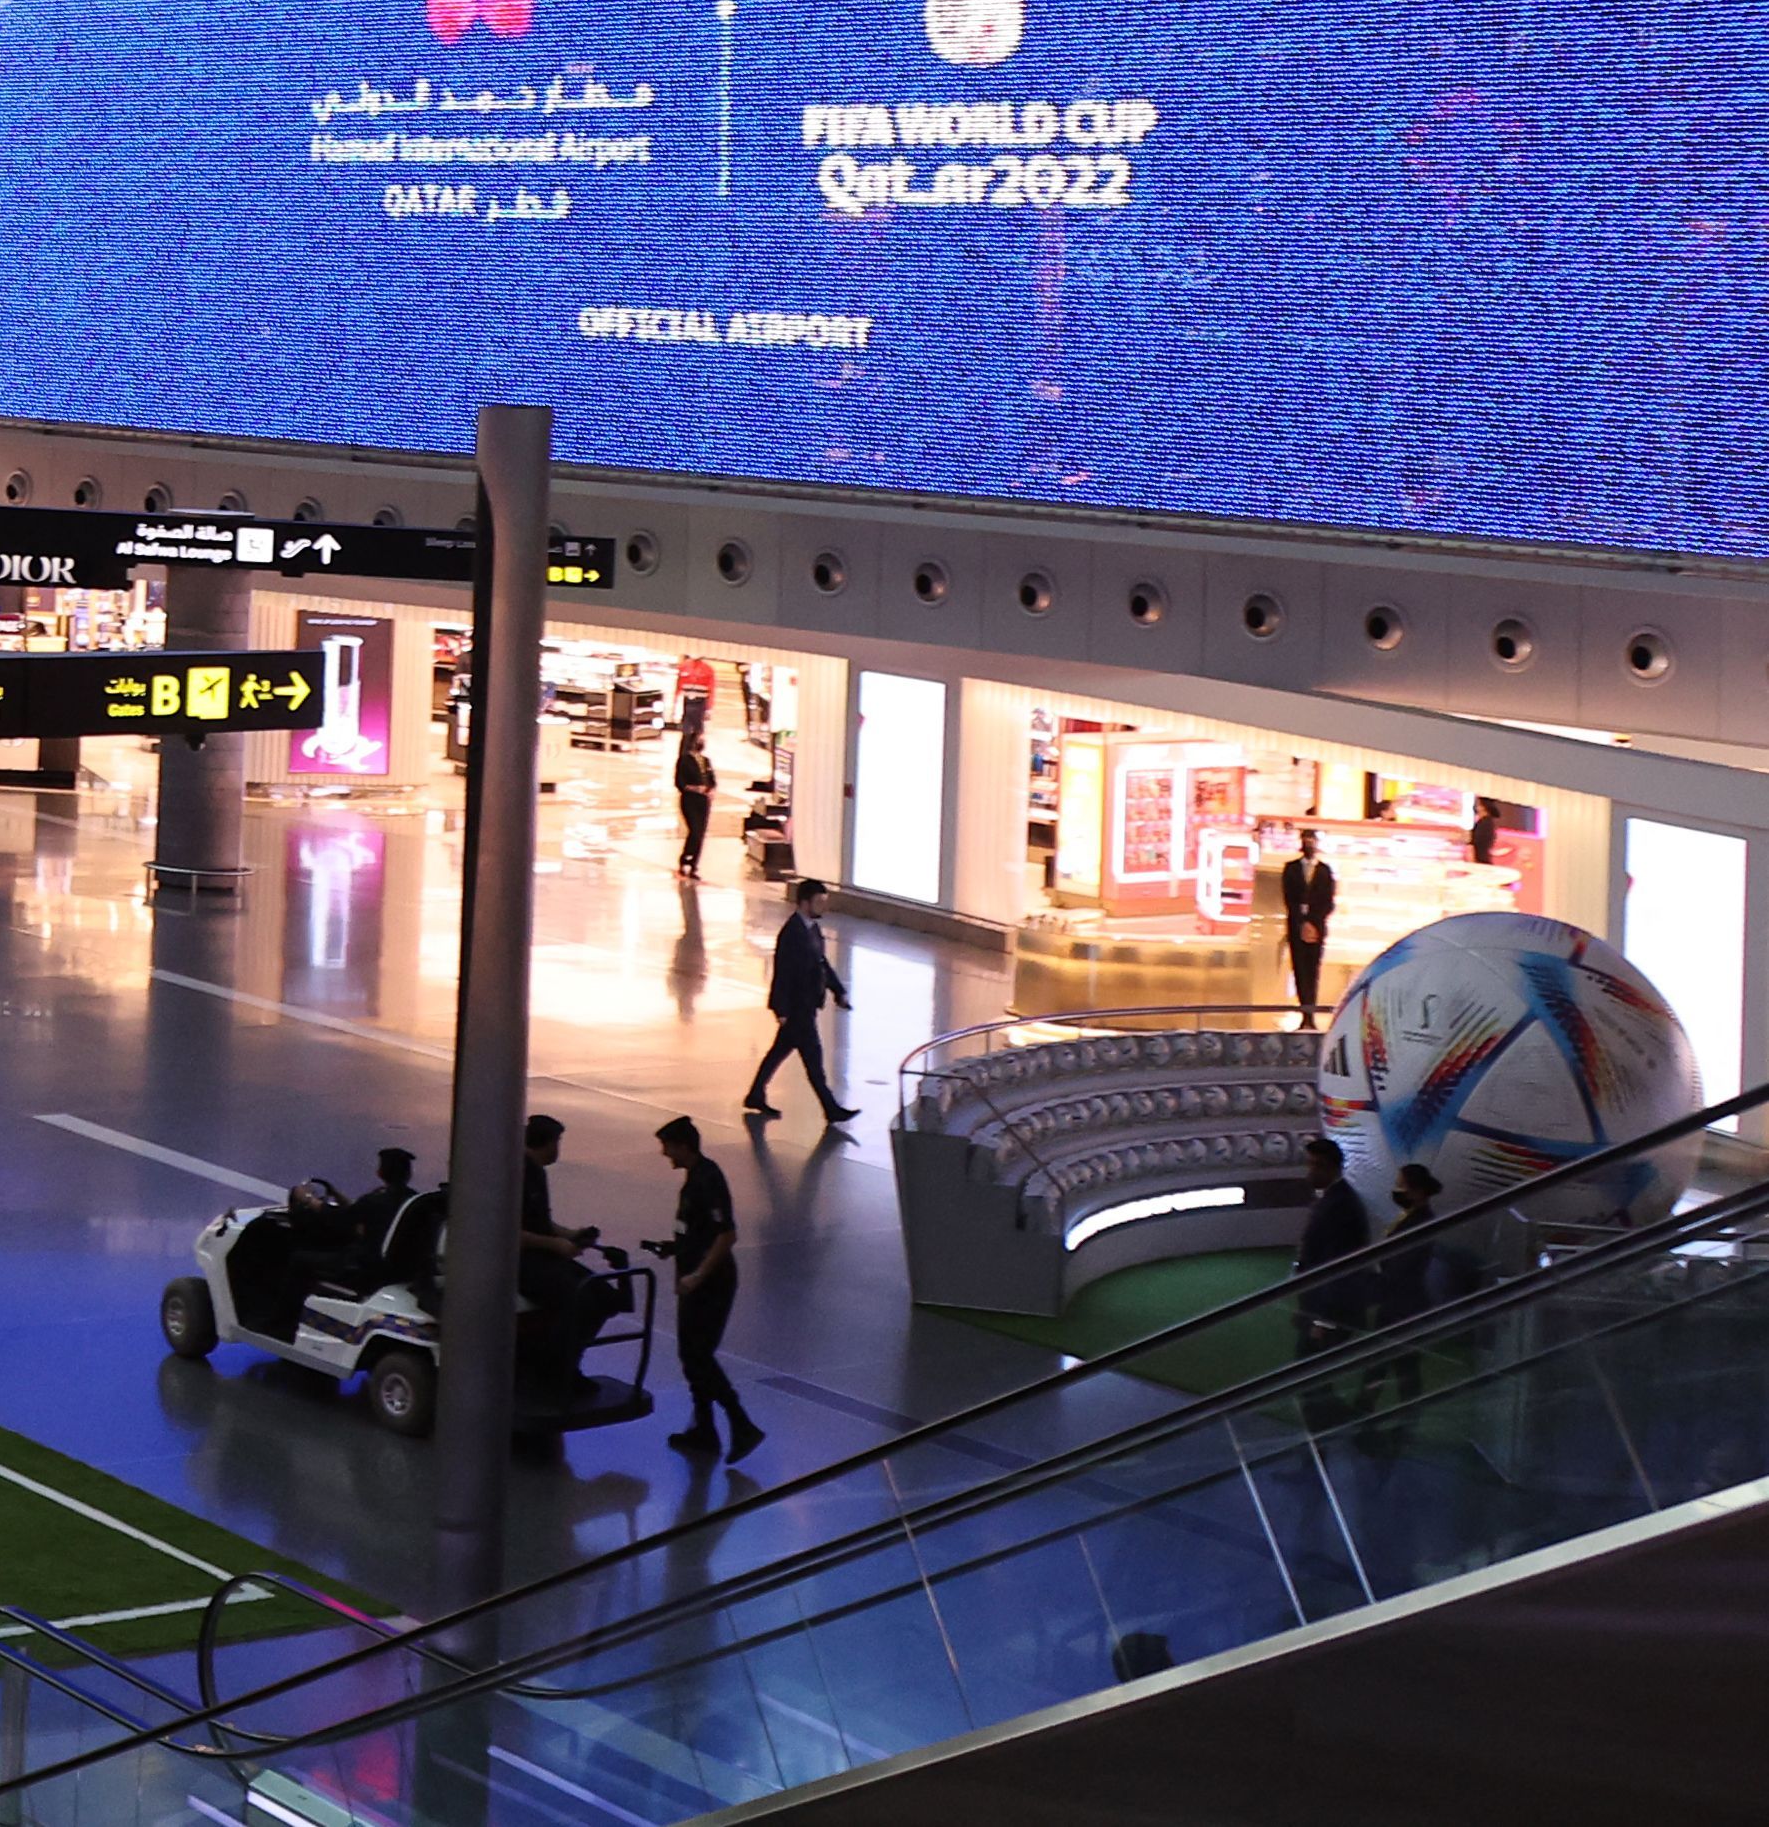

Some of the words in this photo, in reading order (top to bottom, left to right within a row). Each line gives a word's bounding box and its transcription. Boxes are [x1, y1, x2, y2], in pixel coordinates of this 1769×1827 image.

[803, 104, 894, 148] FIFA
[896, 102, 1060, 146] WORLD
[1069, 100, 1159, 144] CUP
[383, 184, 479, 219] QATAR
[579, 306, 722, 343] OFFICIAL
[726, 312, 874, 348] AIRPORT
[115, 541, 134, 555] Al
[179, 545, 233, 564] Lounge
[152, 675, 181, 716] B
